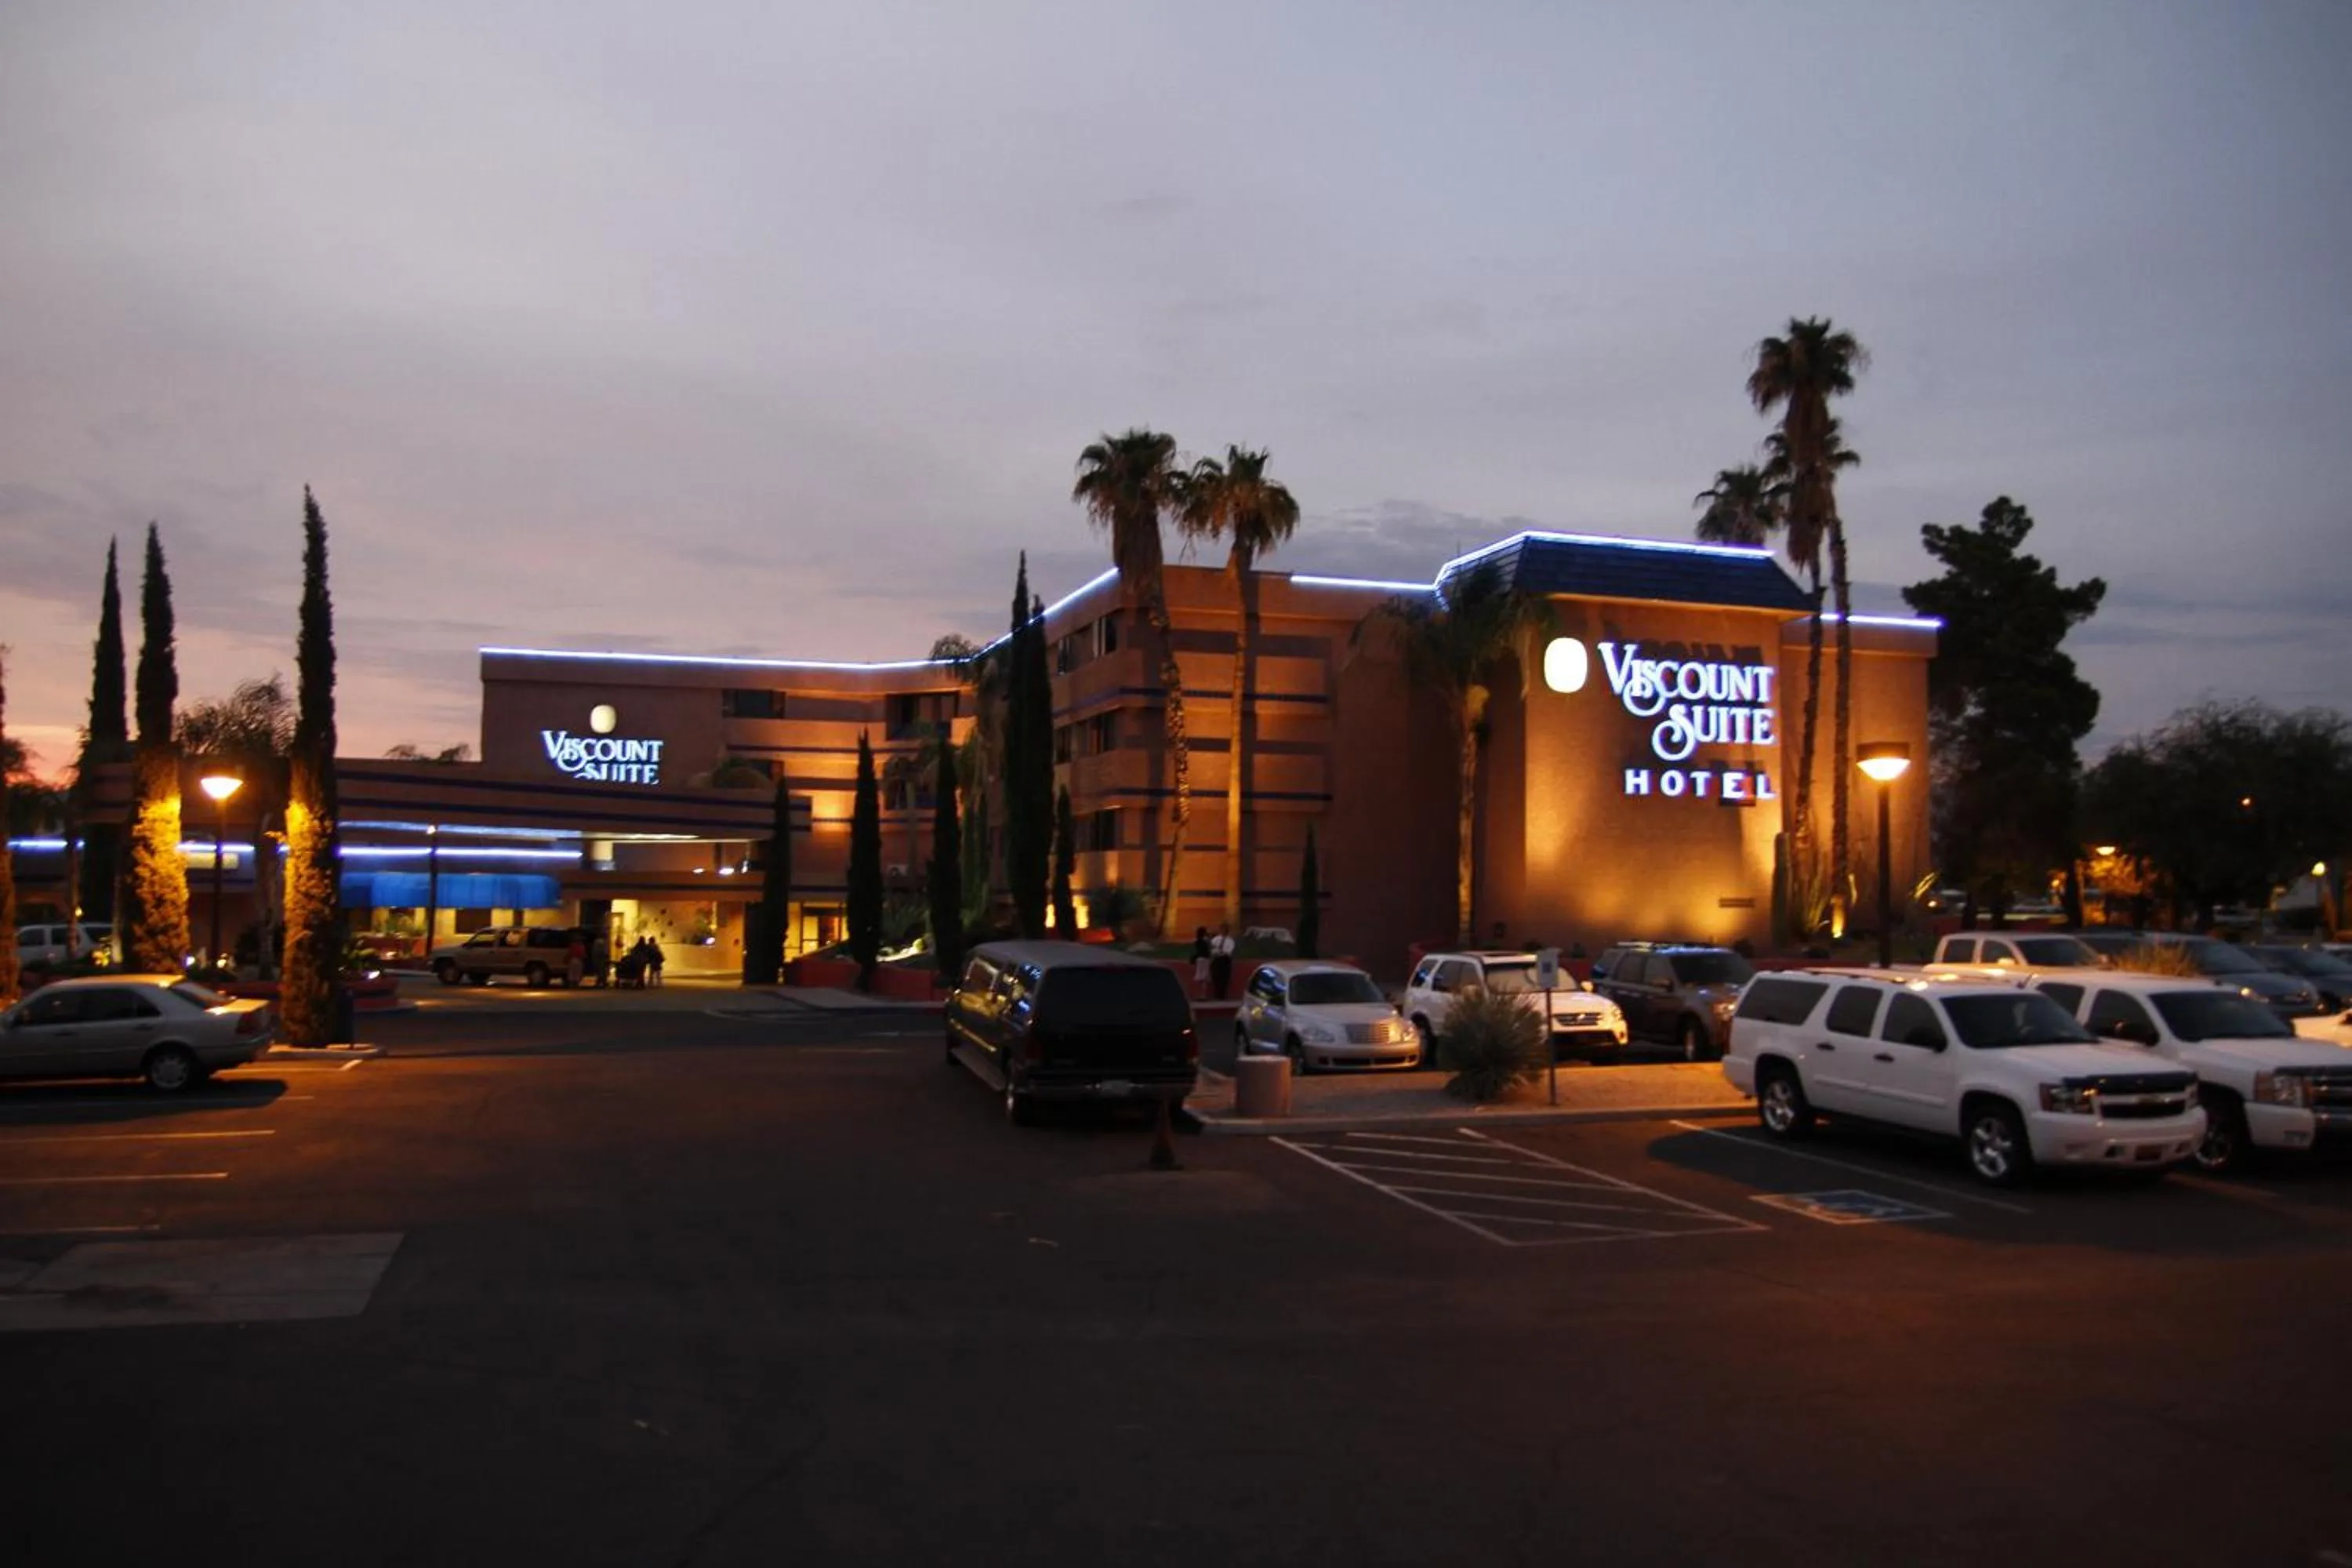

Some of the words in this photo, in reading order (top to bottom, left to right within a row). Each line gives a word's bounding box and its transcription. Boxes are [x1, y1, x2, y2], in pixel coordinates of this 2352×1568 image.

[1597, 641, 1775, 717] VISCOUNT
[540, 729, 664, 772] VISCOUNT
[1651, 703, 1777, 761] SUITE
[1624, 768, 1777, 800] HOTEL
